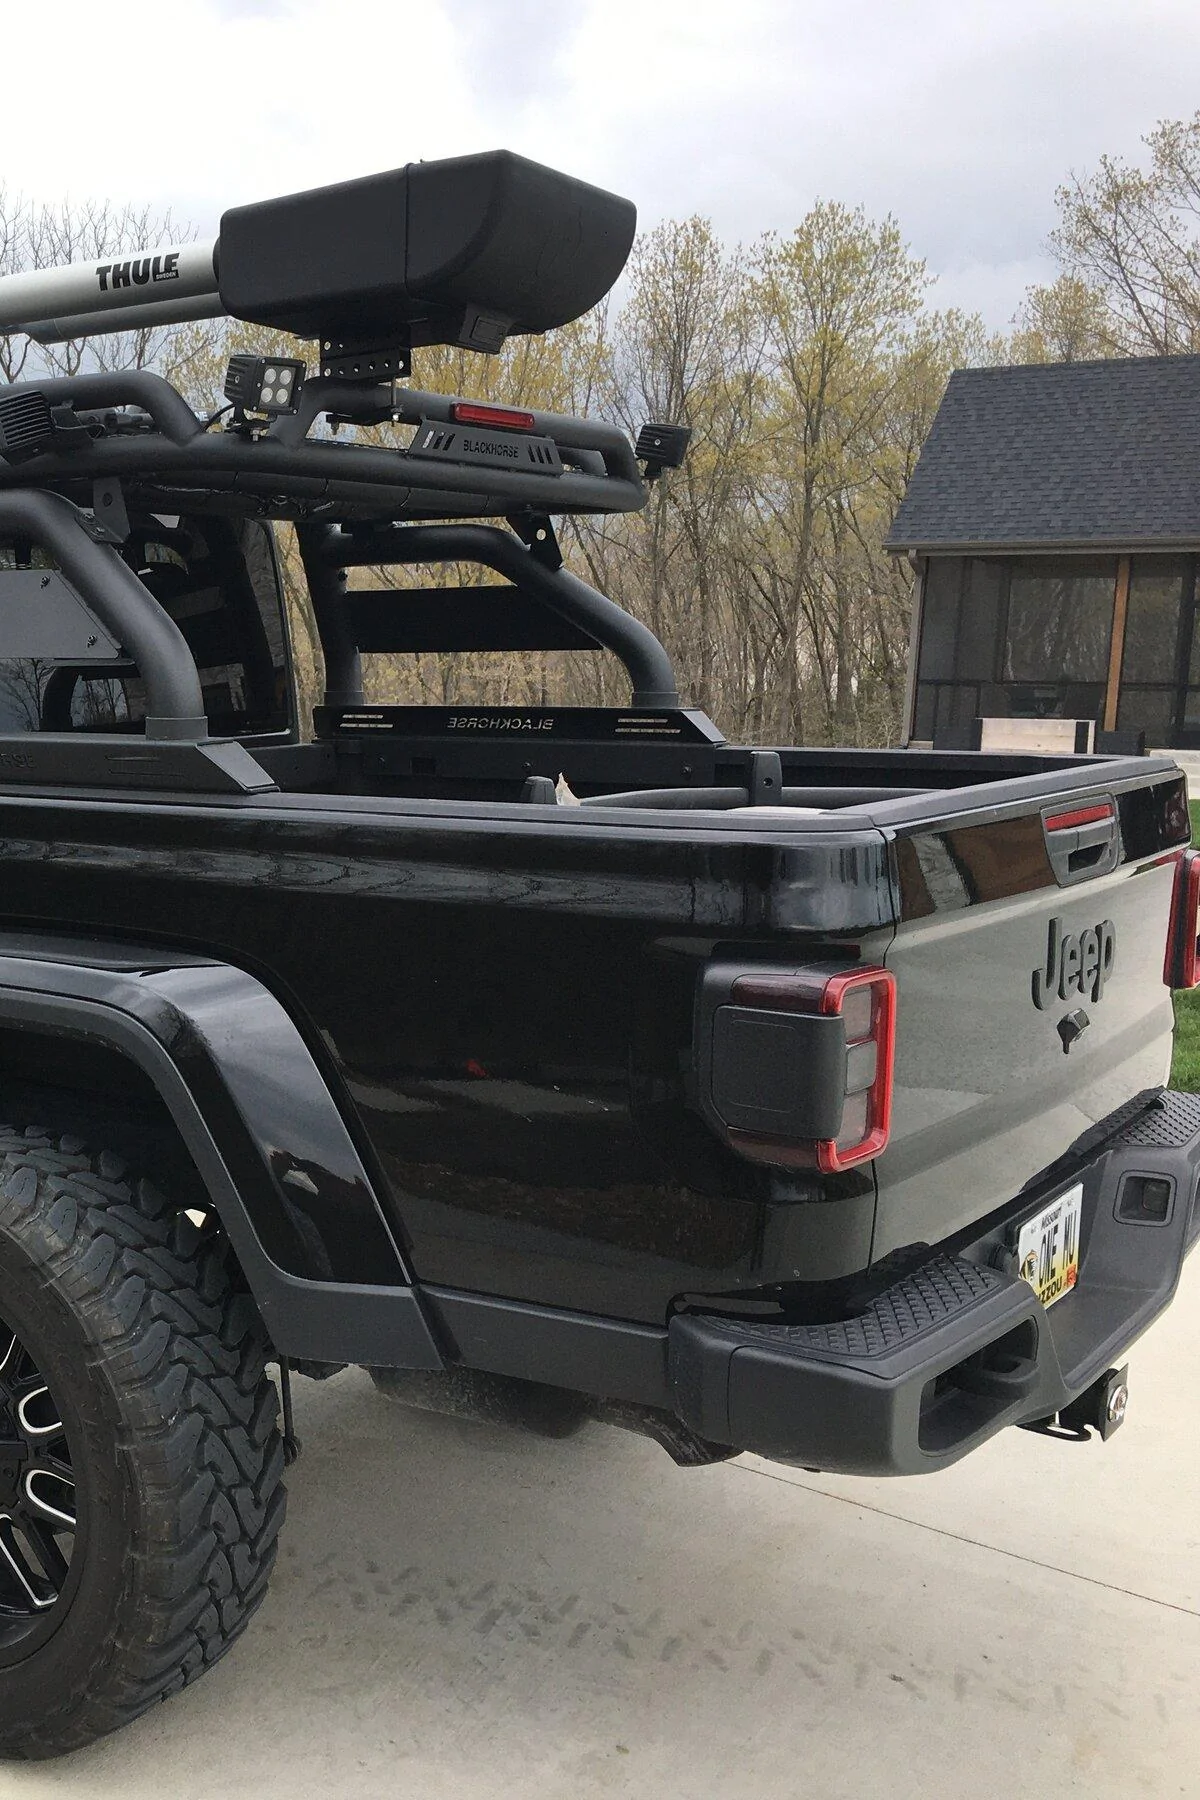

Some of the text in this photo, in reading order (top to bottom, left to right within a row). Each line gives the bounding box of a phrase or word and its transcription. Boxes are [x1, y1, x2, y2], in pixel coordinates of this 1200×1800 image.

[96, 252, 180, 291] THULE
[463, 440, 519, 458] BLACKHORSE
[1031, 917, 1116, 1011] Jeep
[1039, 1223, 1058, 1289] ONE
[1039, 1276, 1062, 1304] ZZOU
